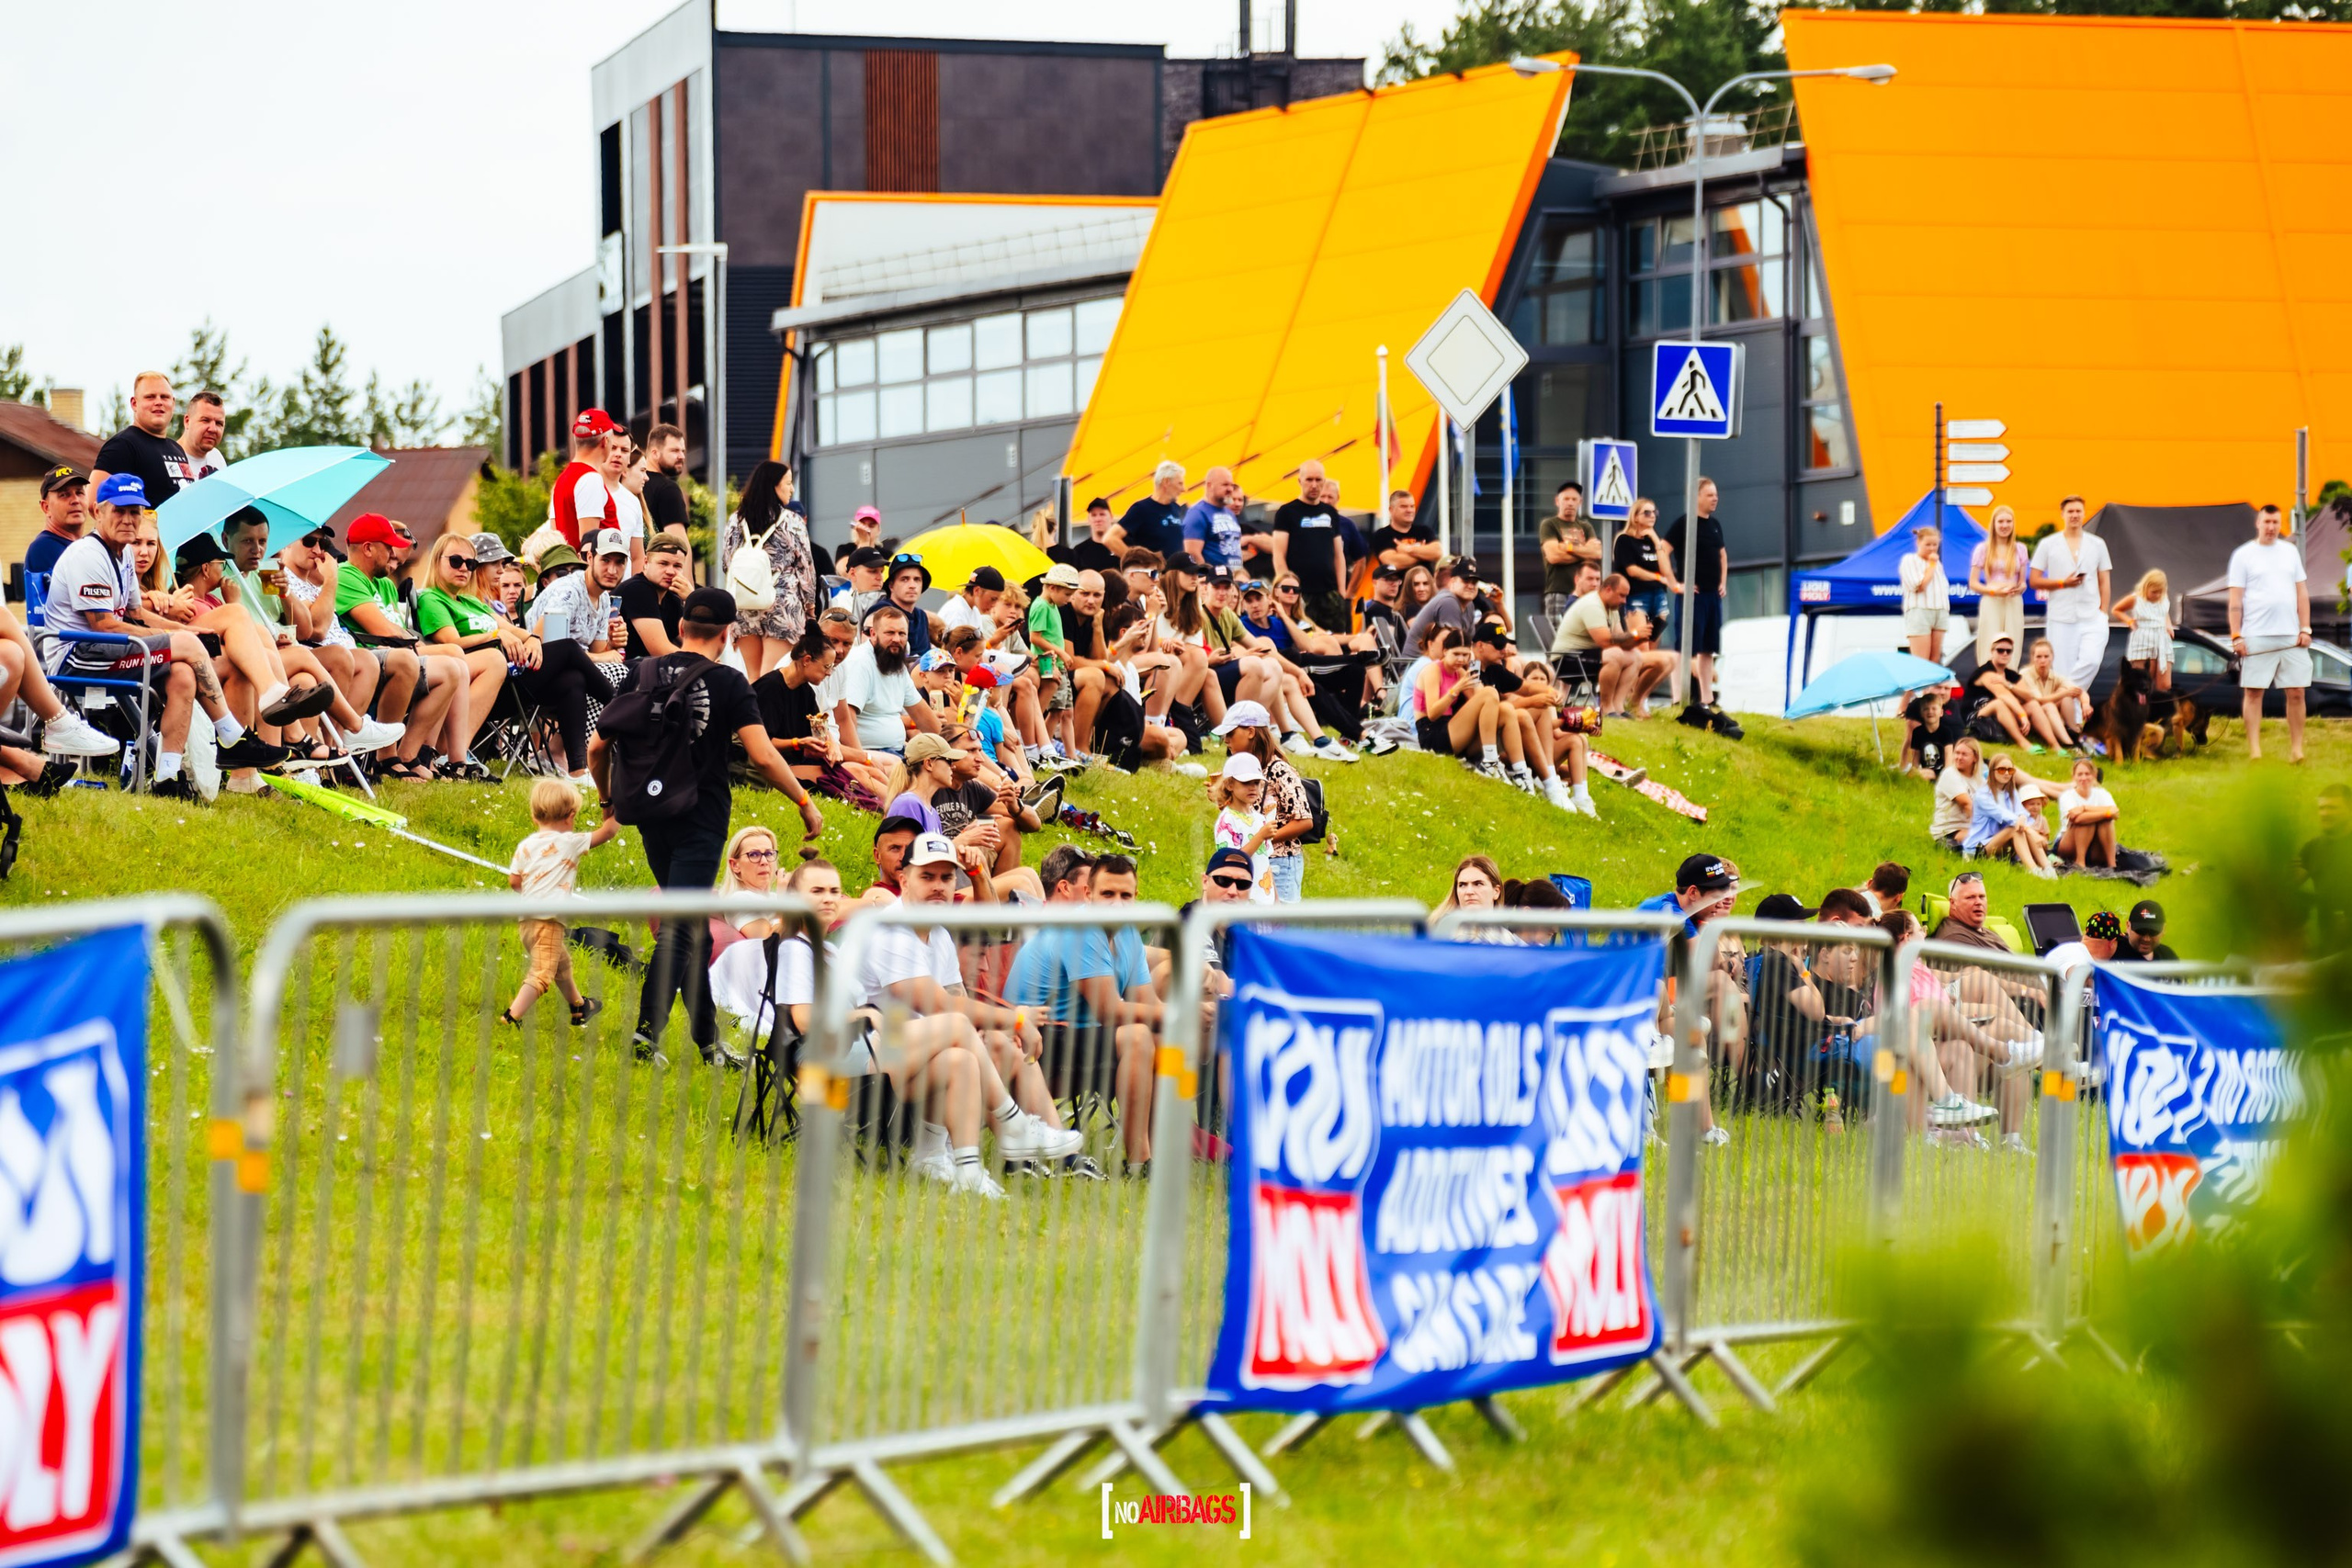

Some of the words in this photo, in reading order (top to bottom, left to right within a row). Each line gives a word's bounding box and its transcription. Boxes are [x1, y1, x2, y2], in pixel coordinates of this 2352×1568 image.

[83, 586, 111, 597] PILSENER
[1379, 1018, 1483, 1128] MOTOR
[1482, 1021, 1544, 1128] OILS
